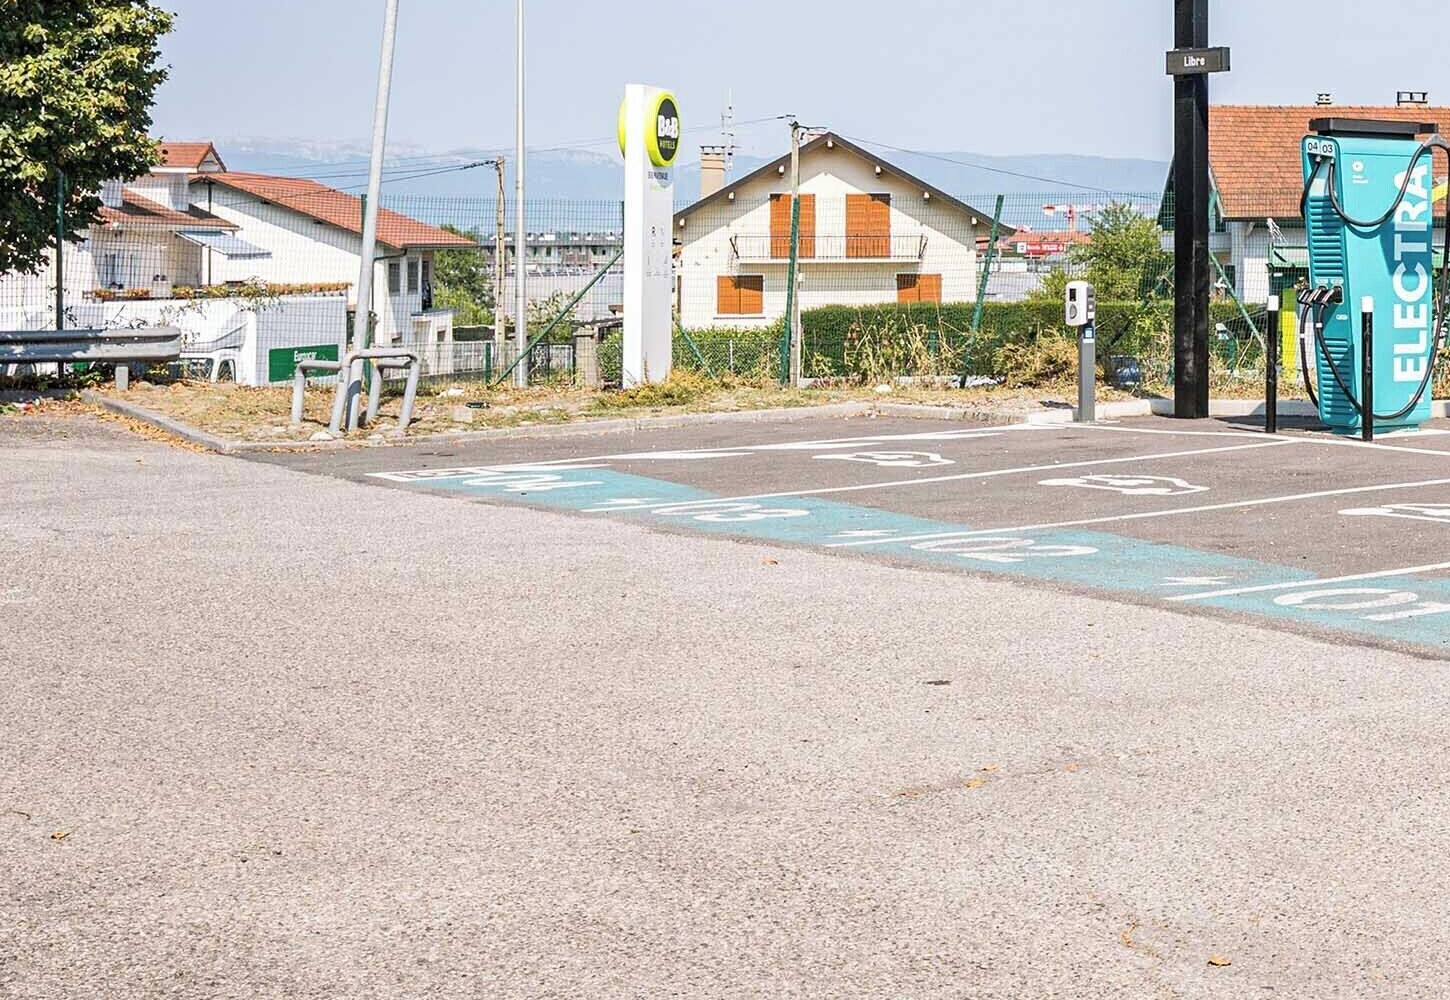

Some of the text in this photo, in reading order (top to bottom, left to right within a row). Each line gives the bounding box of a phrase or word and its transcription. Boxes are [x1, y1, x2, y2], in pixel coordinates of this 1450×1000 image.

[1183, 55, 1206, 67] Libre
[658, 115, 679, 138] B&B
[659, 139, 676, 150] HOTELS
[1308, 142, 1318, 151] 04
[1321, 144, 1333, 153] 03
[1393, 164, 1428, 383] ELECTRA
[462, 474, 605, 492] 04
[651, 502, 811, 522] 03
[911, 537, 1099, 562] 02
